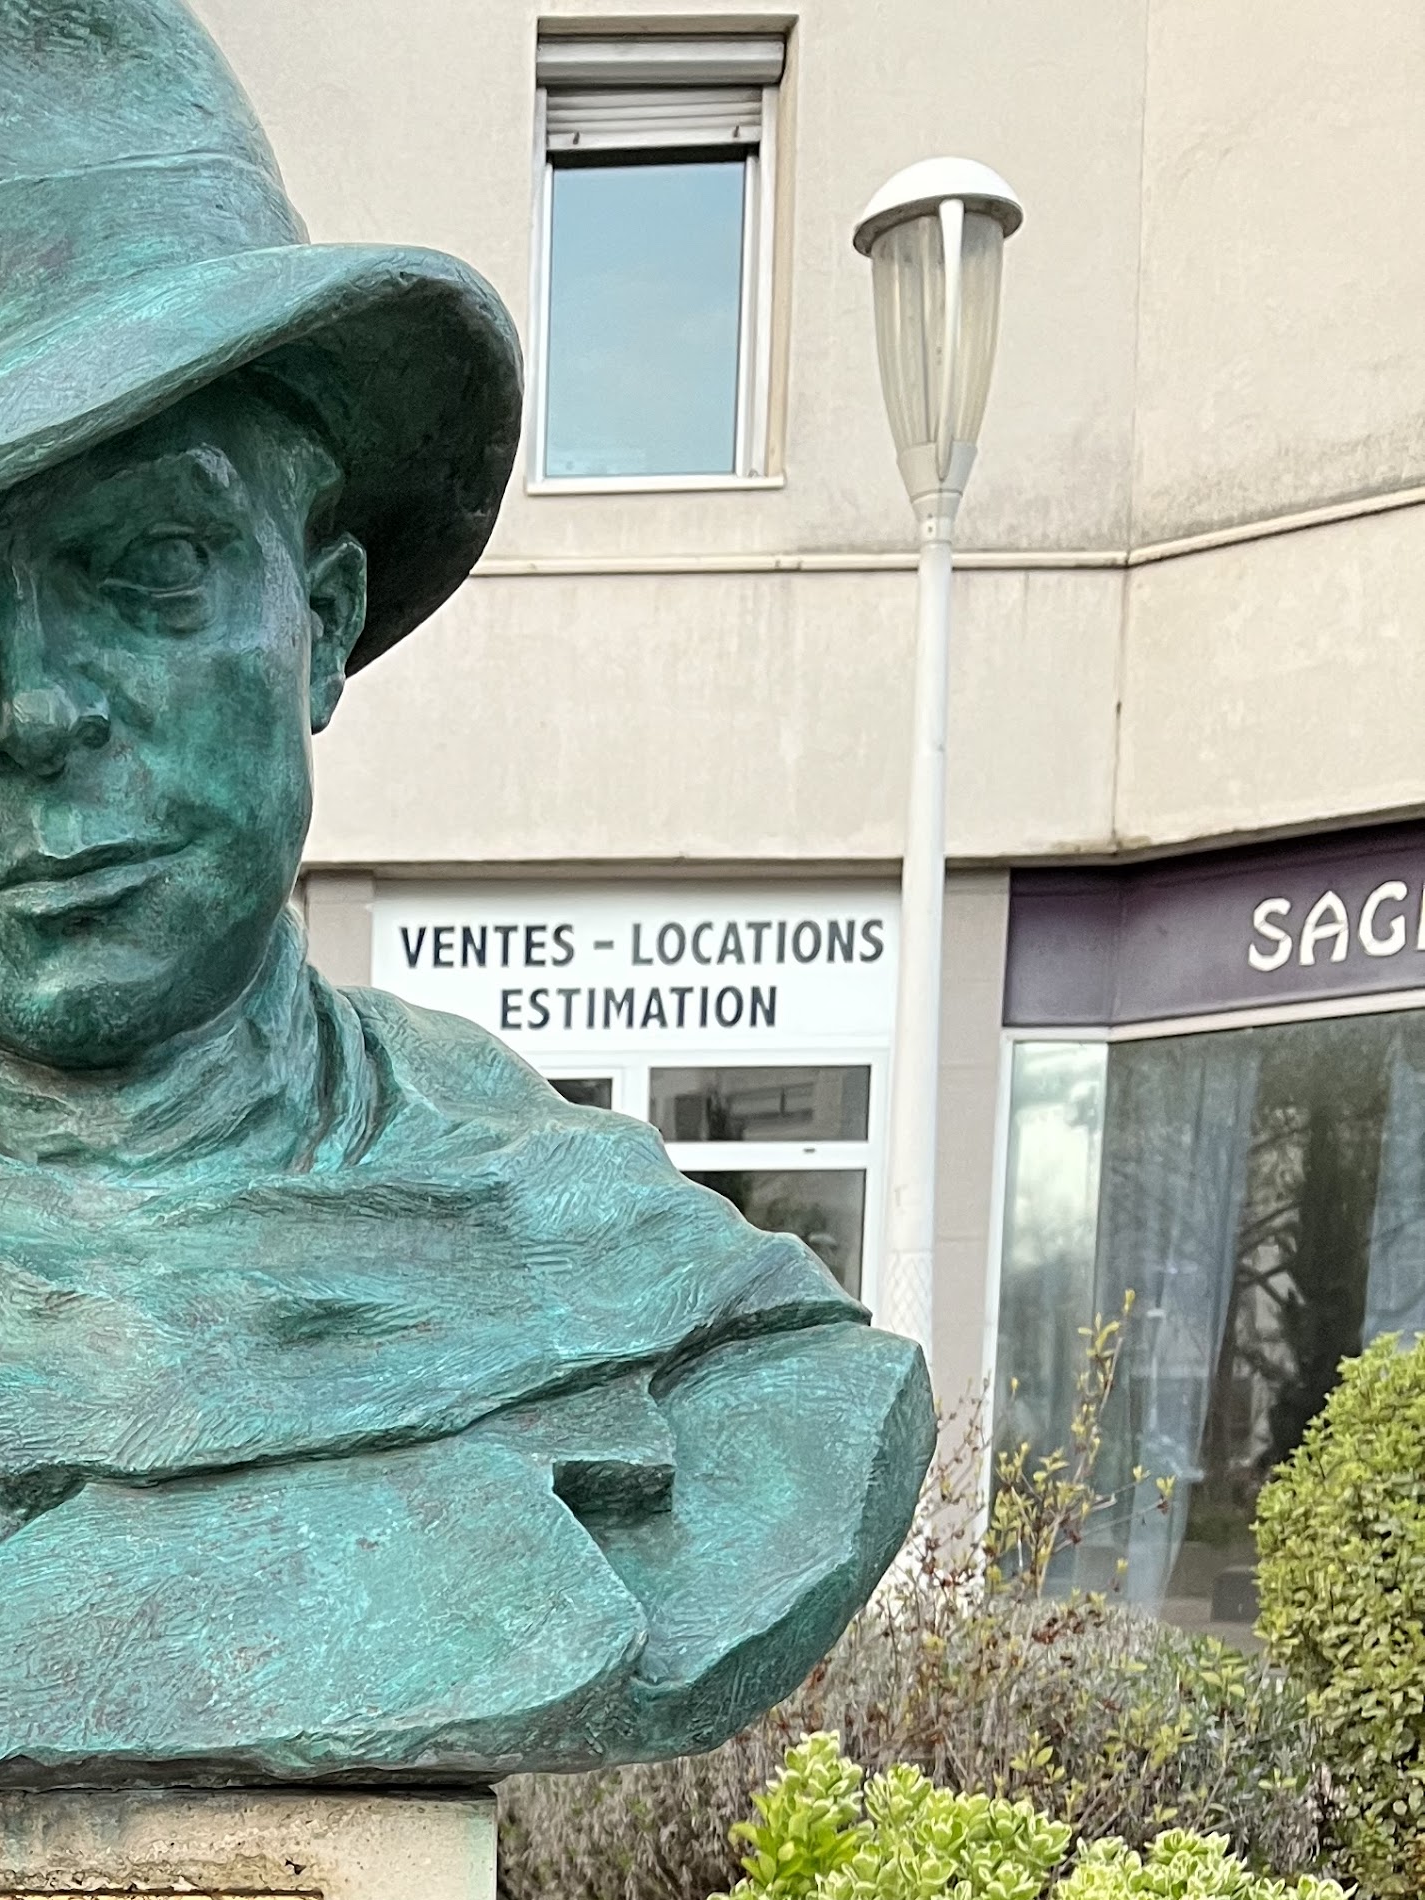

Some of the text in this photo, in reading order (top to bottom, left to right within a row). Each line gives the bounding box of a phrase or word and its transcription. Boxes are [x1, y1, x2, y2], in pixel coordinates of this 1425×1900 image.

[399, 922, 576, 970] VENTES
[631, 919, 885, 966] LOCATIONS
[1248, 880, 1425, 972] SAG
[499, 984, 778, 1032] ESTIMATION
